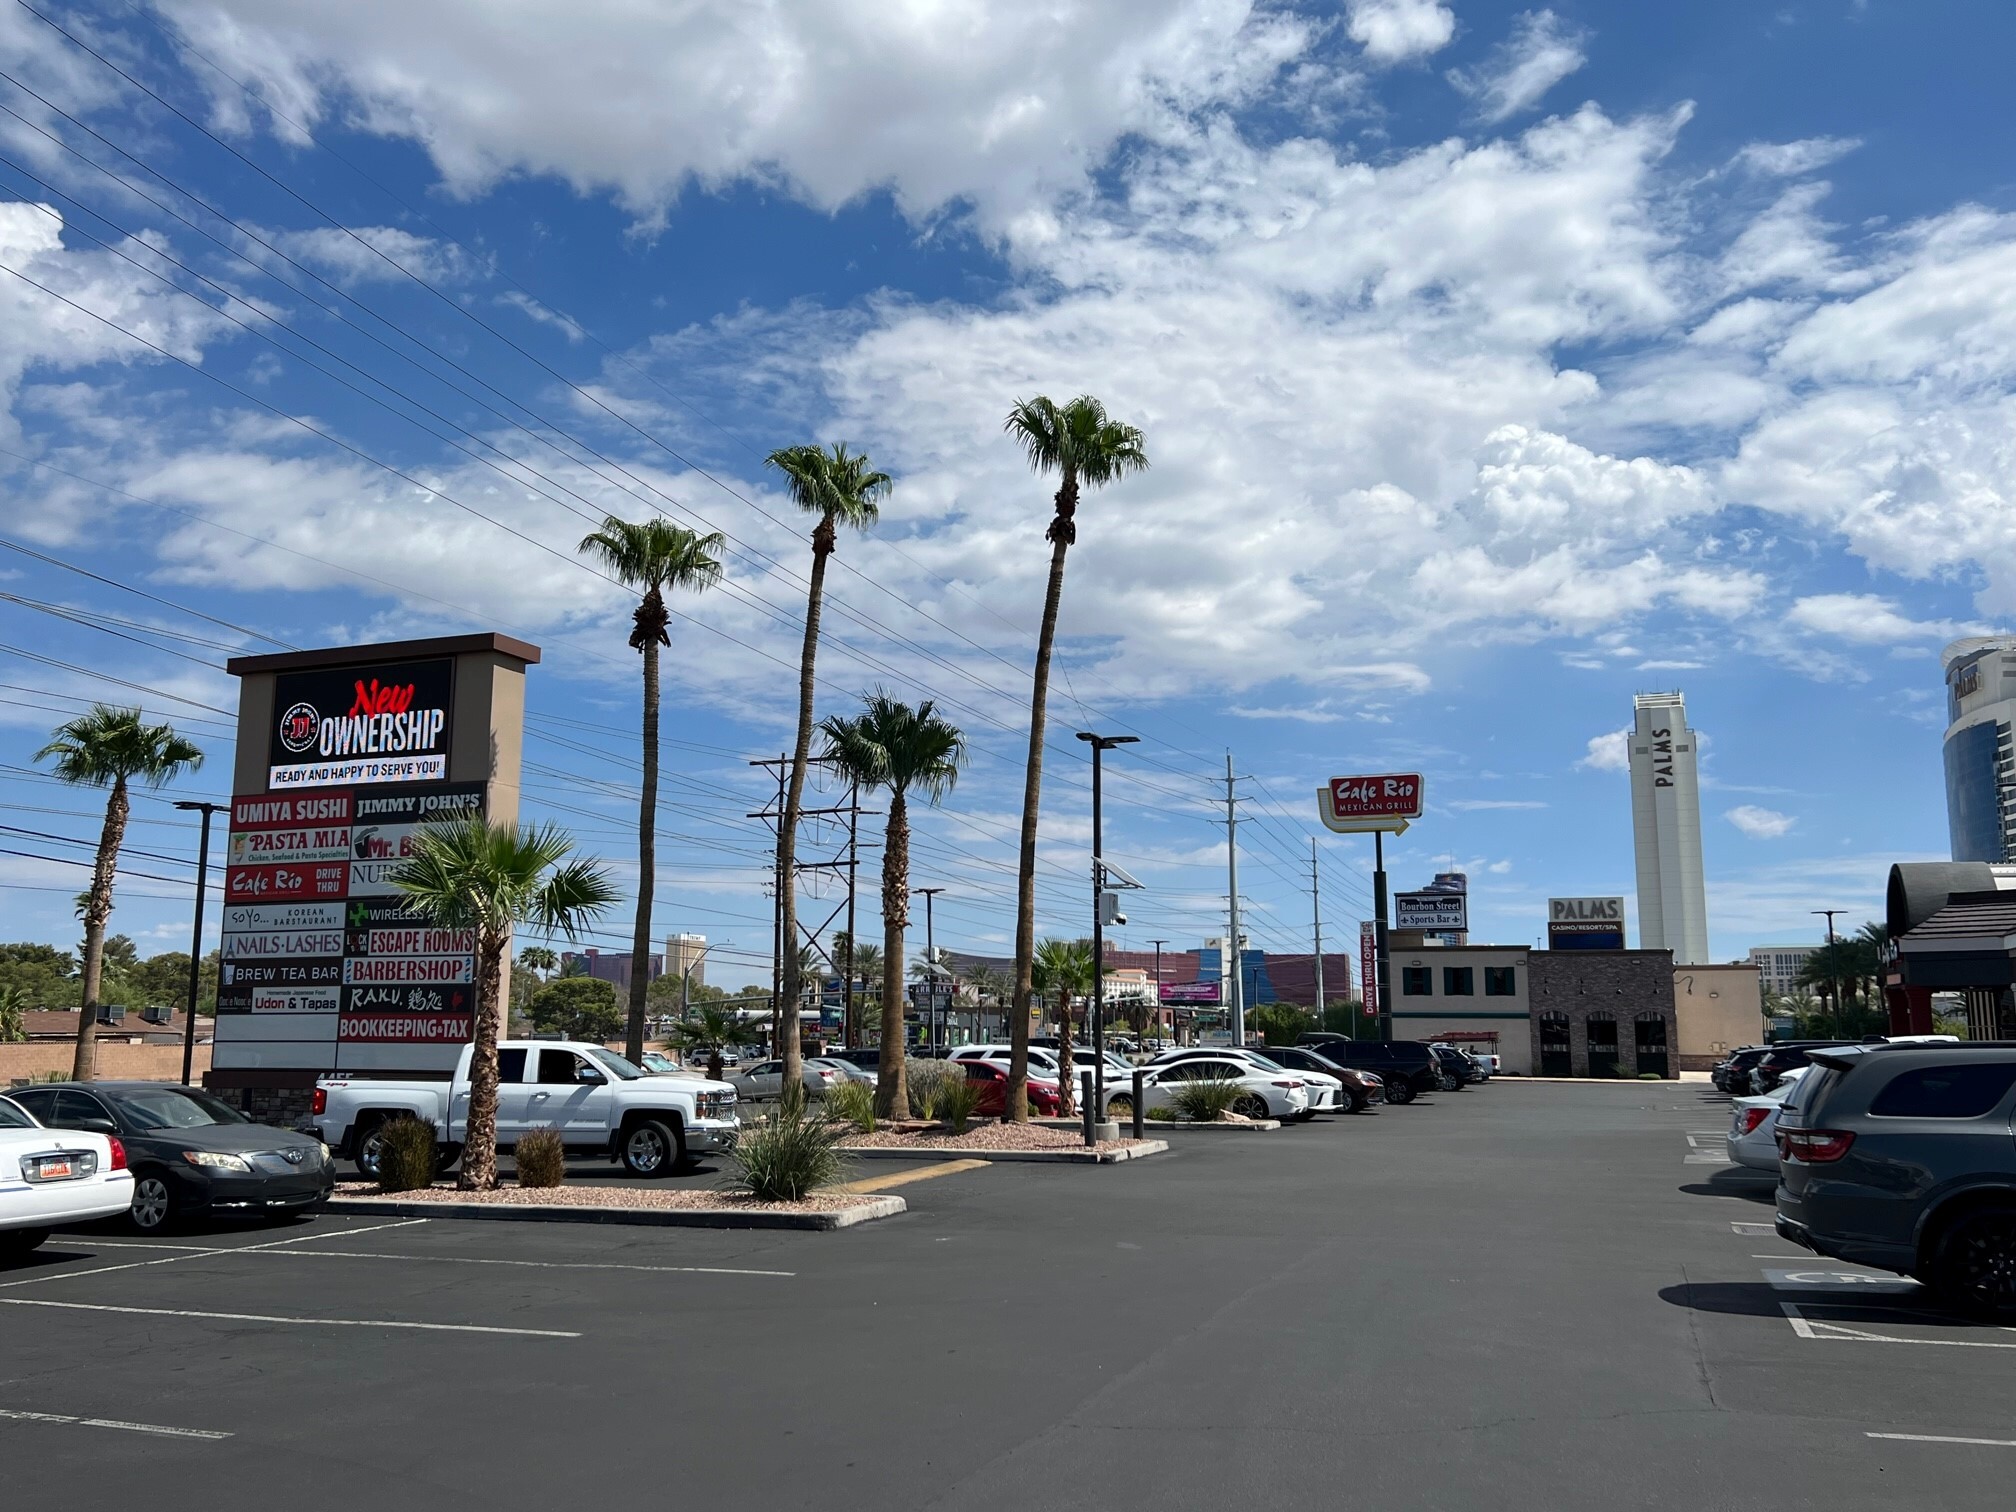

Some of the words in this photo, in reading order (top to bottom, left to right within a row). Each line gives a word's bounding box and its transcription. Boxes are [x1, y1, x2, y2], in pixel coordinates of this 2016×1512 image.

[348, 678, 415, 720] New
[319, 708, 445, 757] OWNERSHIP
[1652, 728, 1674, 788] PALMS
[275, 769, 305, 783] READY
[308, 768, 329, 781] AND
[331, 766, 364, 780] HAPPY
[366, 764, 379, 778] TO
[380, 762, 413, 776] SERVE
[416, 761, 440, 774] YOU!
[1336, 780, 1377, 803] Cafe
[236, 801, 292, 824] UMIYA
[296, 798, 348, 820] SUSHI
[357, 797, 416, 818] JIMMY
[418, 793, 481, 814] JOHN'S
[1339, 802, 1383, 812] MEXICAN
[1386, 801, 1413, 810] GRILL
[249, 832, 309, 852] PASTA
[313, 829, 350, 849] MIA
[367, 836, 395, 858] Mr.
[272, 852, 294, 861] Seafood
[295, 852, 300, 860] &
[301, 852, 318, 860] Pasta
[318, 849, 349, 860] Specialties
[232, 871, 269, 896] Cafe
[316, 867, 342, 880] DRIVE
[316, 881, 340, 893] THRU
[288, 908, 324, 917] KOREAN
[369, 908, 424, 920] WIRELESS
[1401, 901, 1434, 911] Bourbon
[1436, 901, 1460, 910] Street
[1553, 900, 1618, 920] PALMS
[273, 917, 338, 926] BARSTAURANT
[1410, 915, 1435, 925] Sports
[1437, 914, 1450, 923] Bar
[370, 931, 420, 953] ESCAPE
[423, 930, 474, 953] ROOMS
[1363, 935, 1372, 960] OPEN
[236, 967, 277, 981] BREW
[281, 967, 307, 980] TEA
[311, 966, 339, 980] BAR
[352, 960, 463, 981] BARBERSHOP
[1364, 961, 1373, 985] THRU
[255, 997, 285, 1009] Udon
[287, 997, 297, 1009] &
[300, 997, 337, 1011] Tapas
[1365, 986, 1374, 1014] DRIVE
[442, 1019, 468, 1038] TAX
